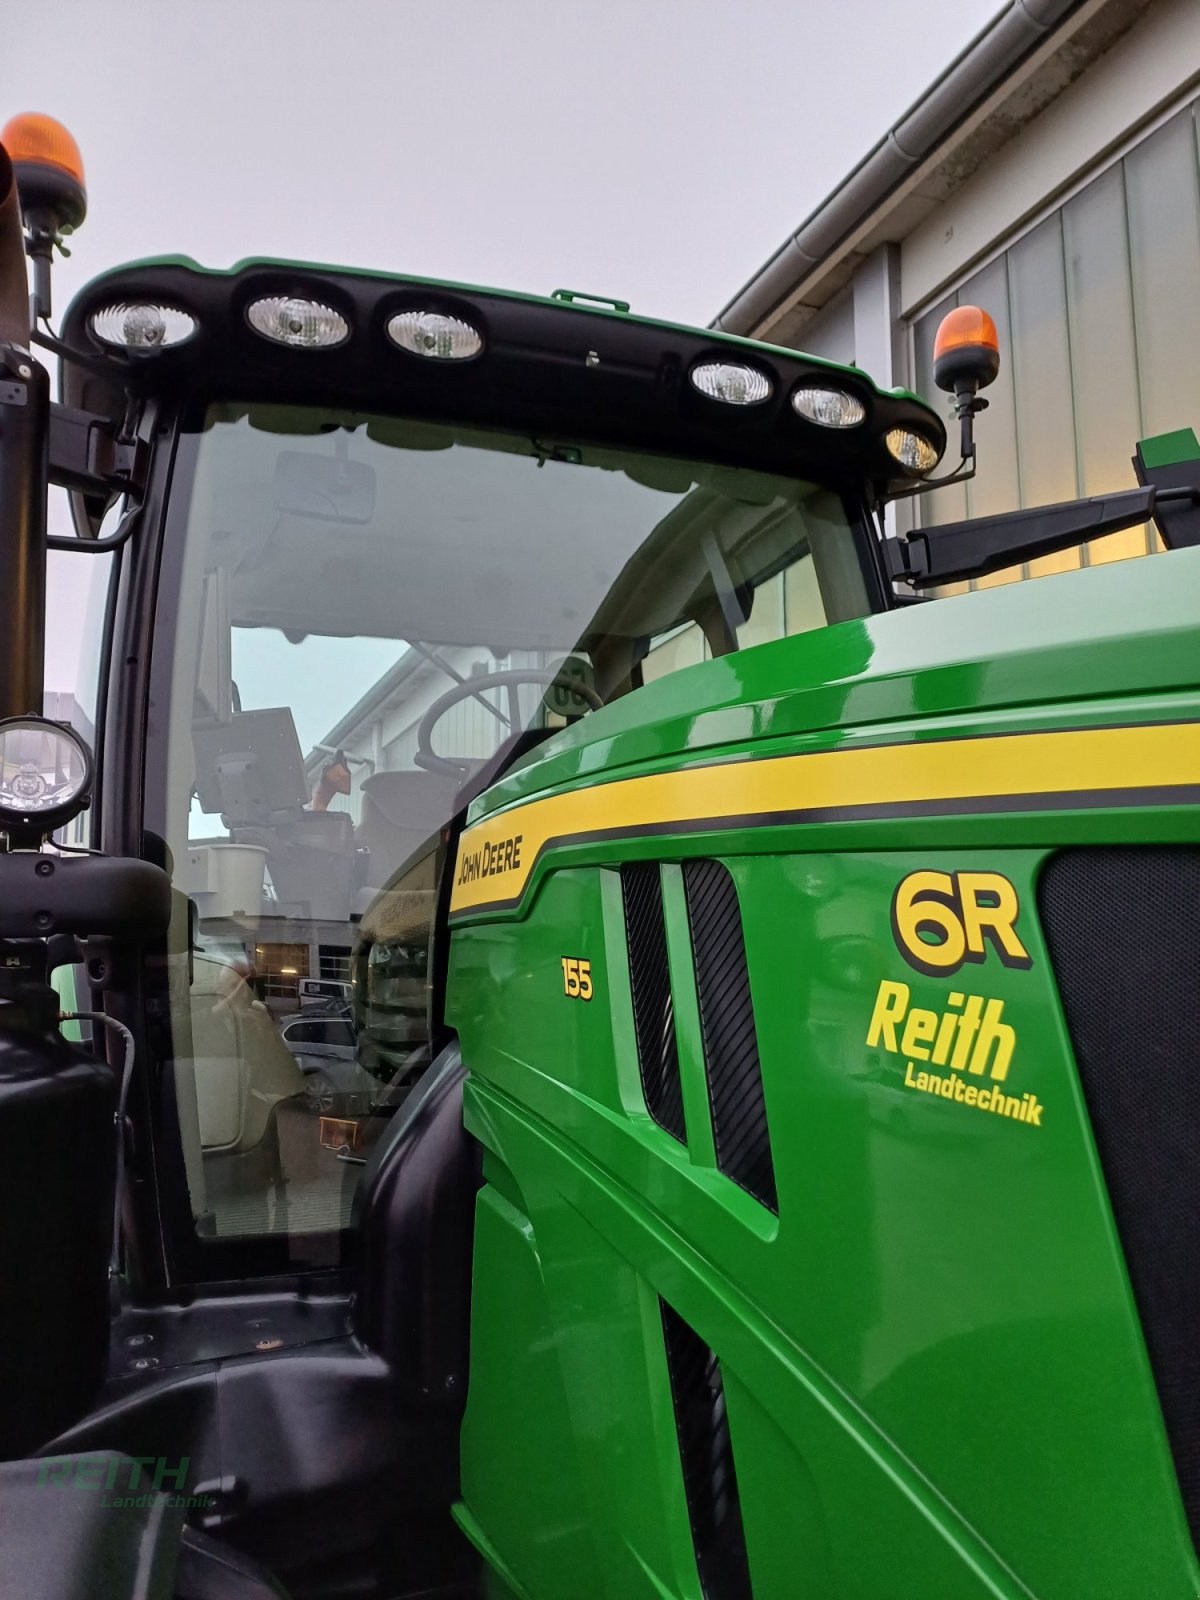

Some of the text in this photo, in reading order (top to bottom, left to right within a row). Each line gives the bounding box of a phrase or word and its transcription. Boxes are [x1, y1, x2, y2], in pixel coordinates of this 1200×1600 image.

[458, 835, 523, 886] JOHN DEERE
[890, 868, 1033, 978] 6R
[561, 955, 593, 1002] 155
[866, 979, 1016, 1082] Reith
[904, 1061, 1044, 1126] Landtechnik
